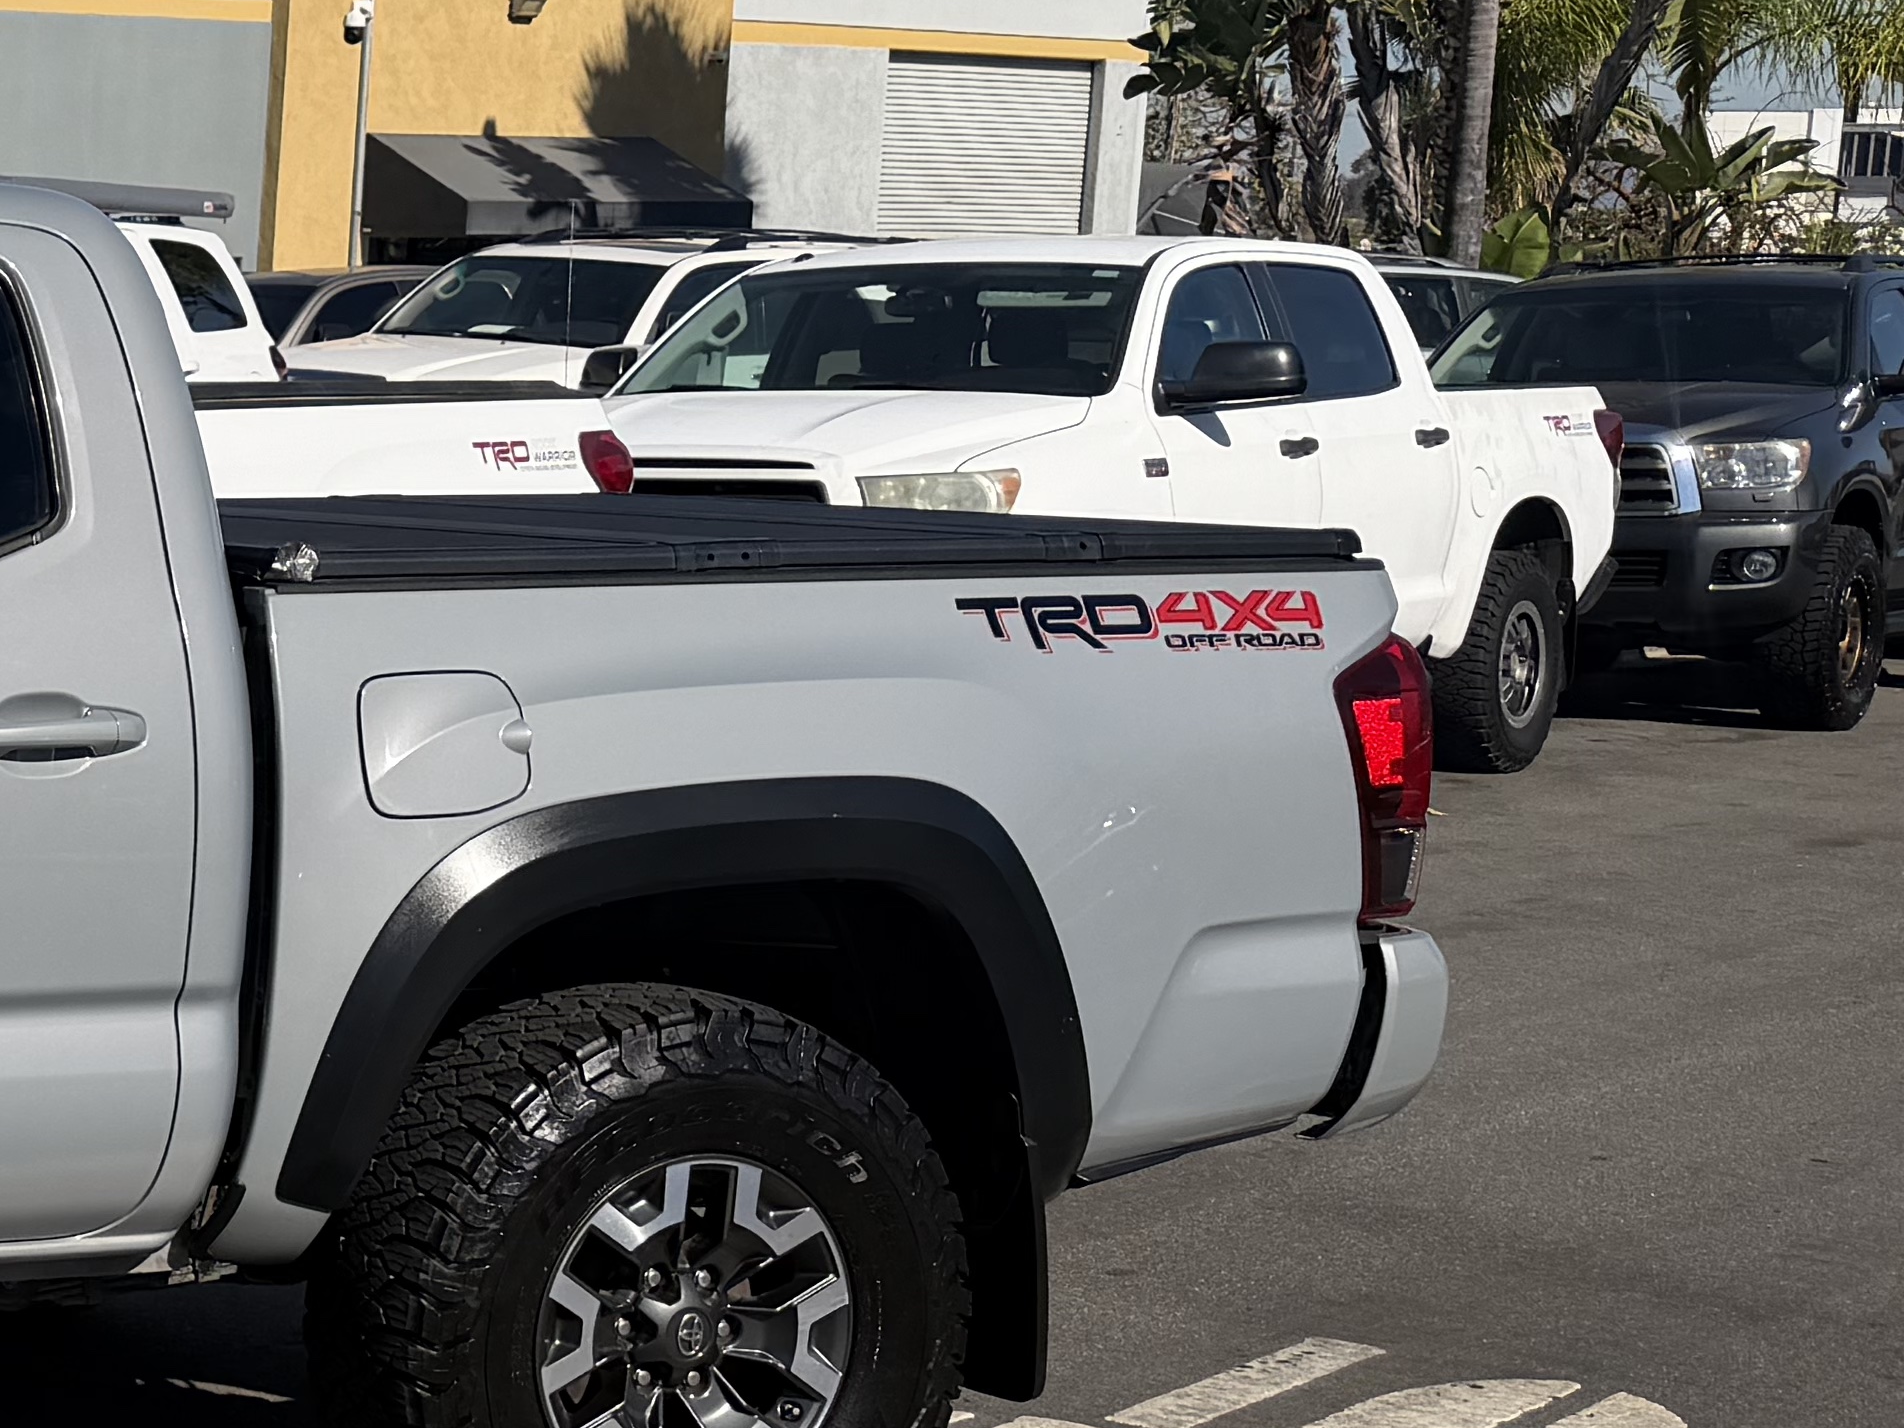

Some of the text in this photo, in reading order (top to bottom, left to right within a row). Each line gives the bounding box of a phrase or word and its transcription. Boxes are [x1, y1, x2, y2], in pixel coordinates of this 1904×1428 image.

[471, 440, 531, 471] TRD
[955, 593, 1159, 654] TRD
[1165, 631, 1325, 652] OFF ROAD
